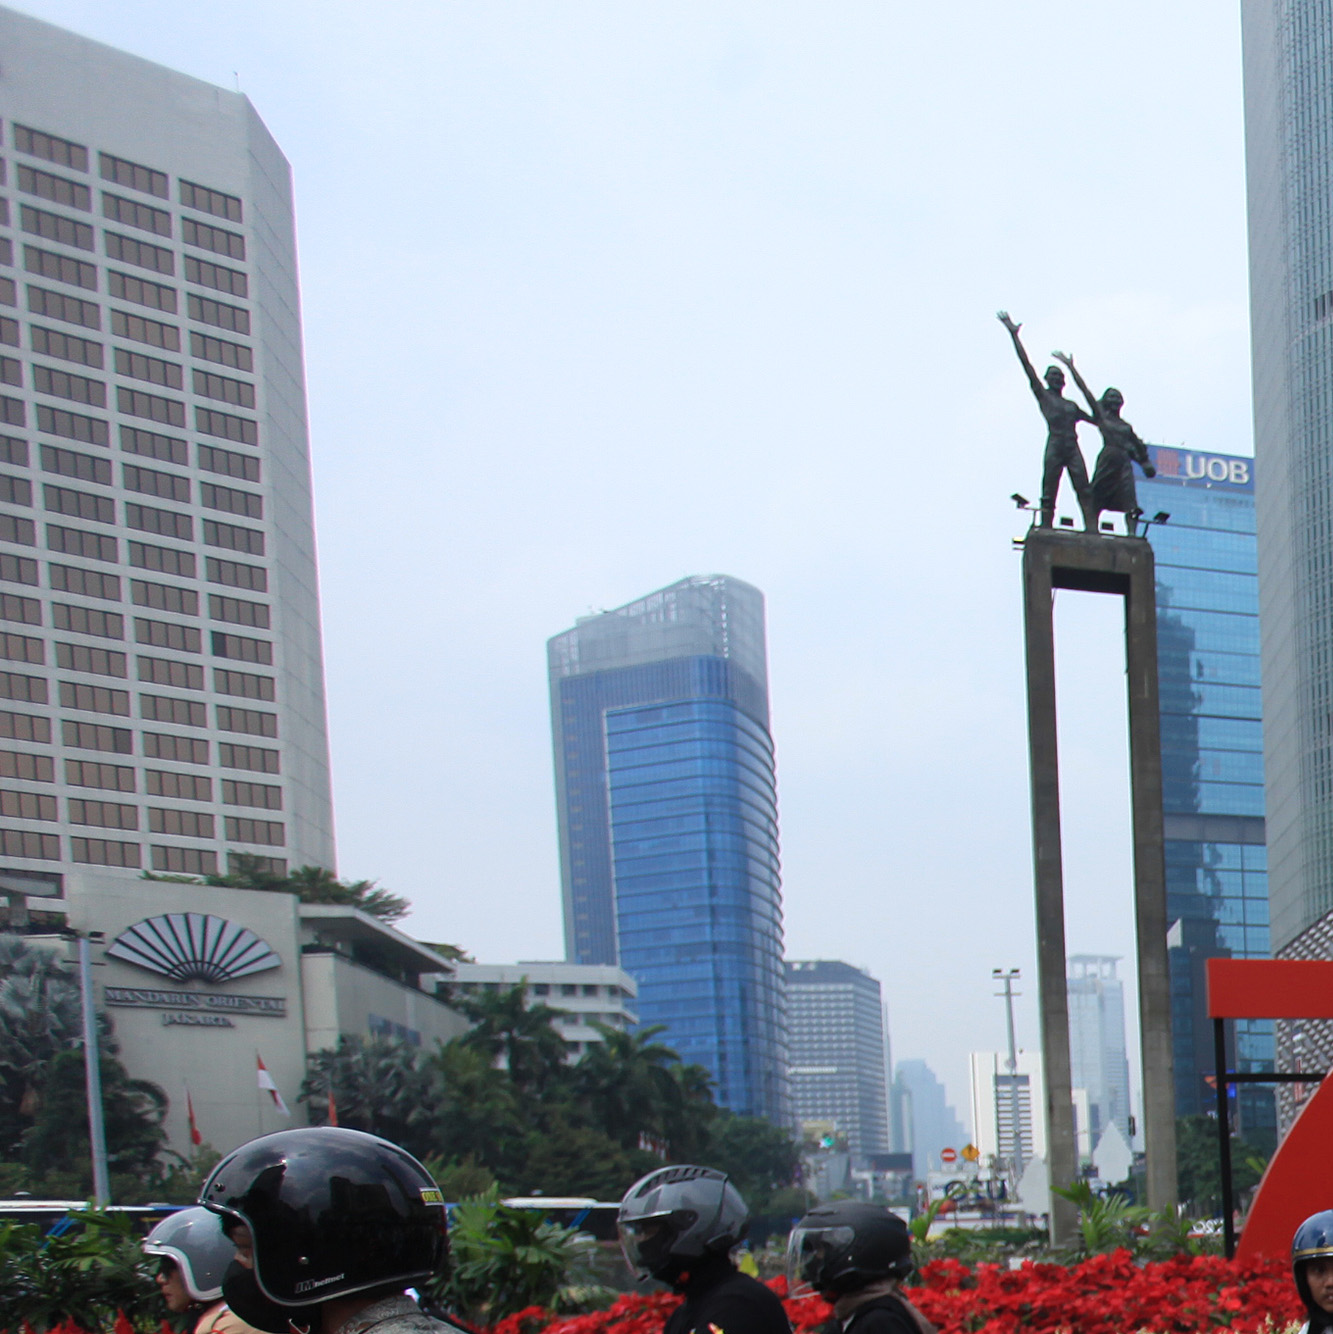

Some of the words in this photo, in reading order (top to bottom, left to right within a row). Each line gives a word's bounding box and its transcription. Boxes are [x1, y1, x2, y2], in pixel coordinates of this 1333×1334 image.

[1185, 454, 1249, 484] UOB
[105, 988, 200, 1006] MANDARIN
[206, 996, 285, 1012] ORIENTAL
[162, 1013, 235, 1028] JAKARTA
